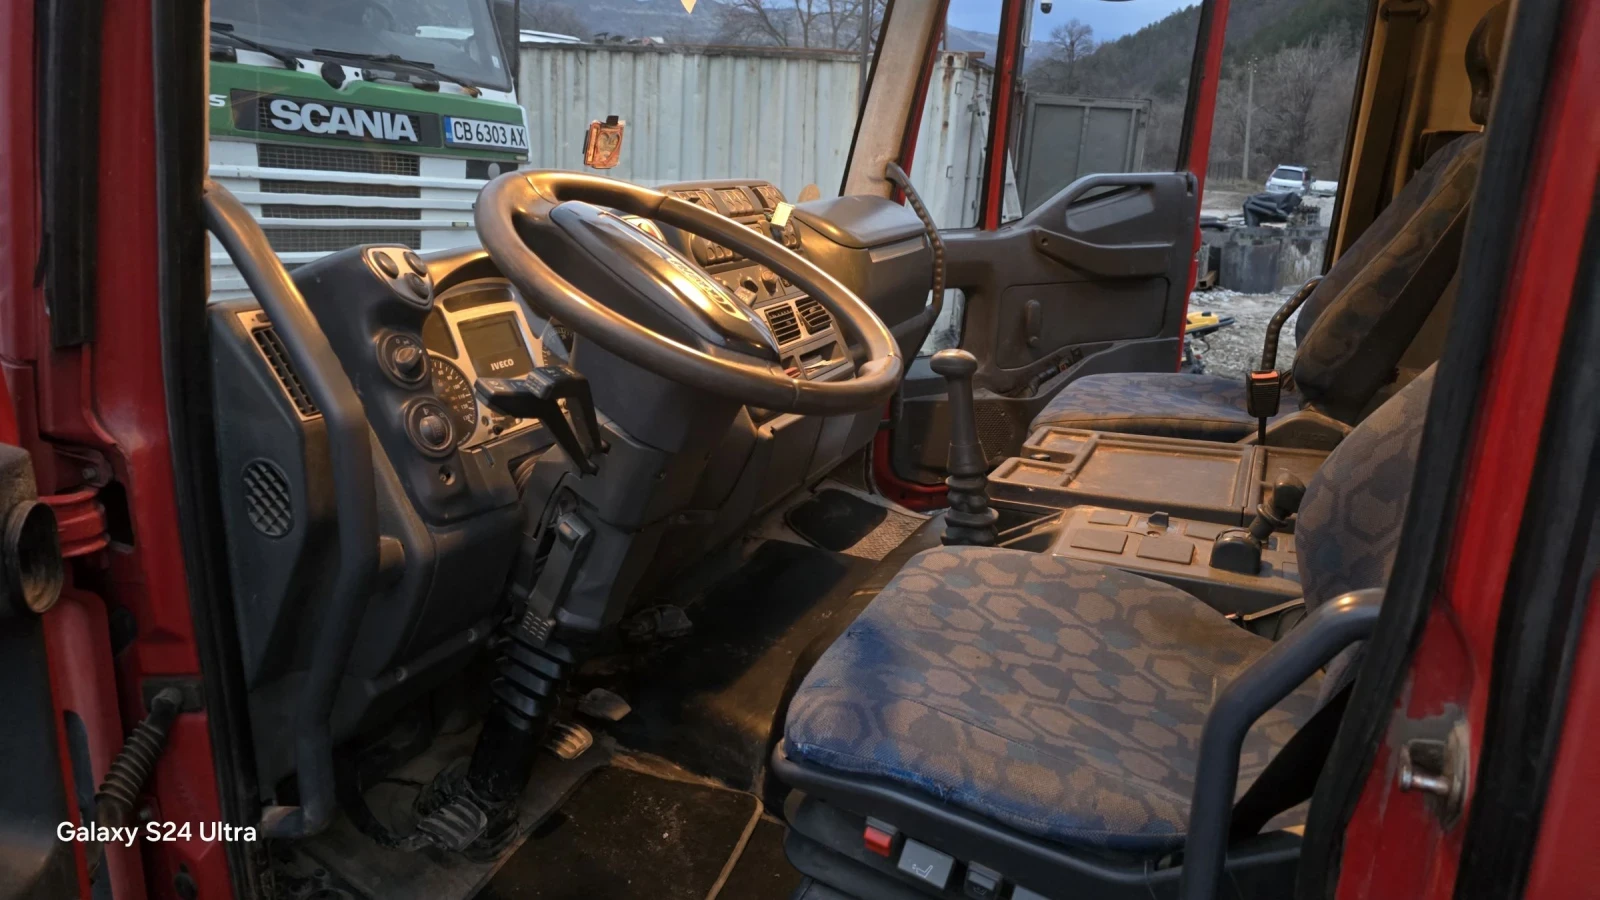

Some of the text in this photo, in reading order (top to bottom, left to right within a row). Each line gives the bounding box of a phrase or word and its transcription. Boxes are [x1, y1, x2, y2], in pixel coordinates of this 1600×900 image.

[269, 98, 419, 143] SCANIA
[453, 120, 527, 147] CB 6303 AX
[490, 358, 515, 371] IVECO
